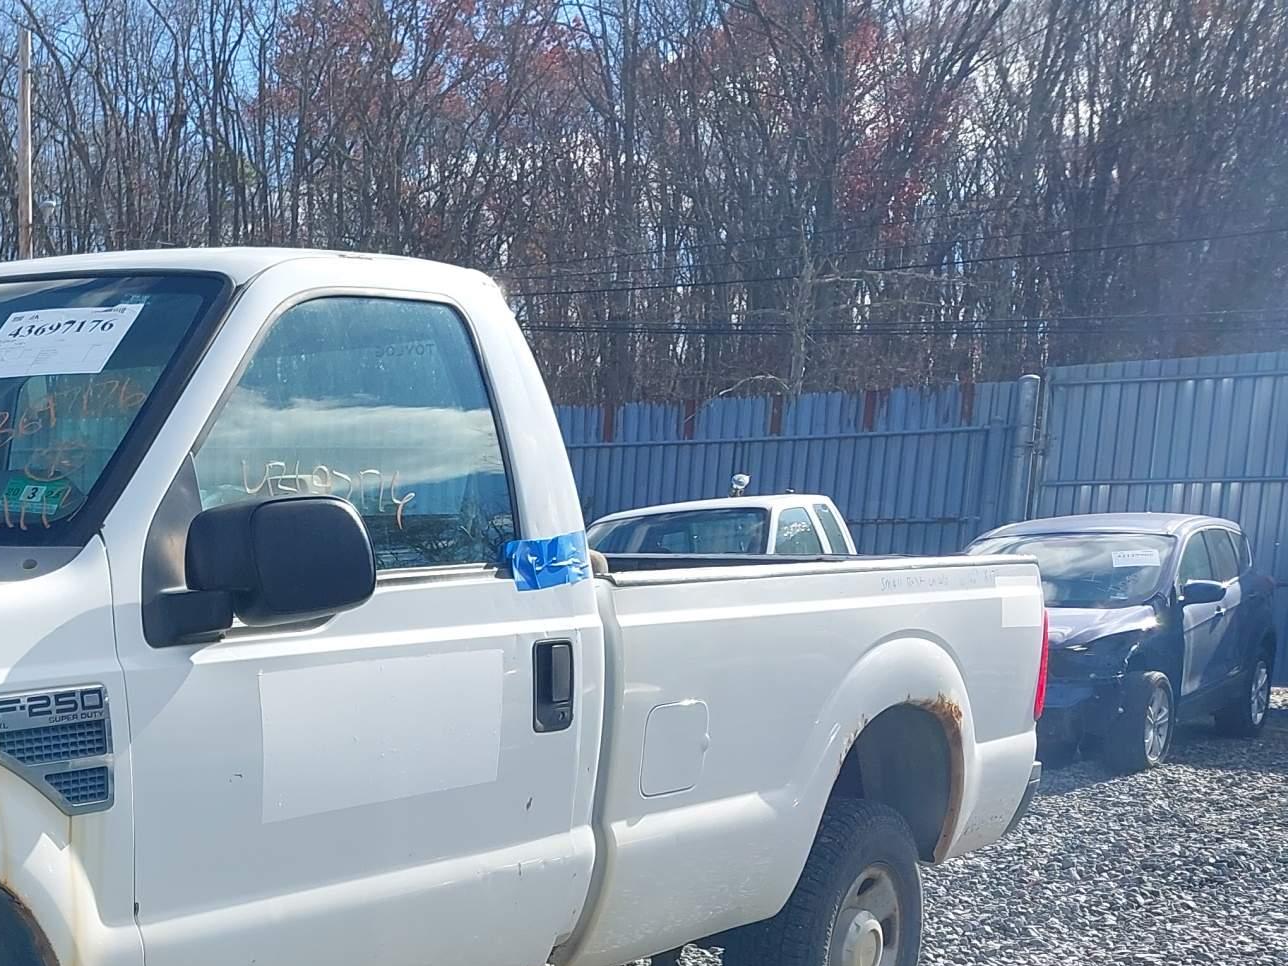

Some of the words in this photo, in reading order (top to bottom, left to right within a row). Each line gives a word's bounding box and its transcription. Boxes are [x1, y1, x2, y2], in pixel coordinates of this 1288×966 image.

[8, 318, 117, 338] 43697176
[27, 486, 39, 500] 3
[48, 713, 79, 724] SUPER
[80, 711, 104, 720] DUTY
